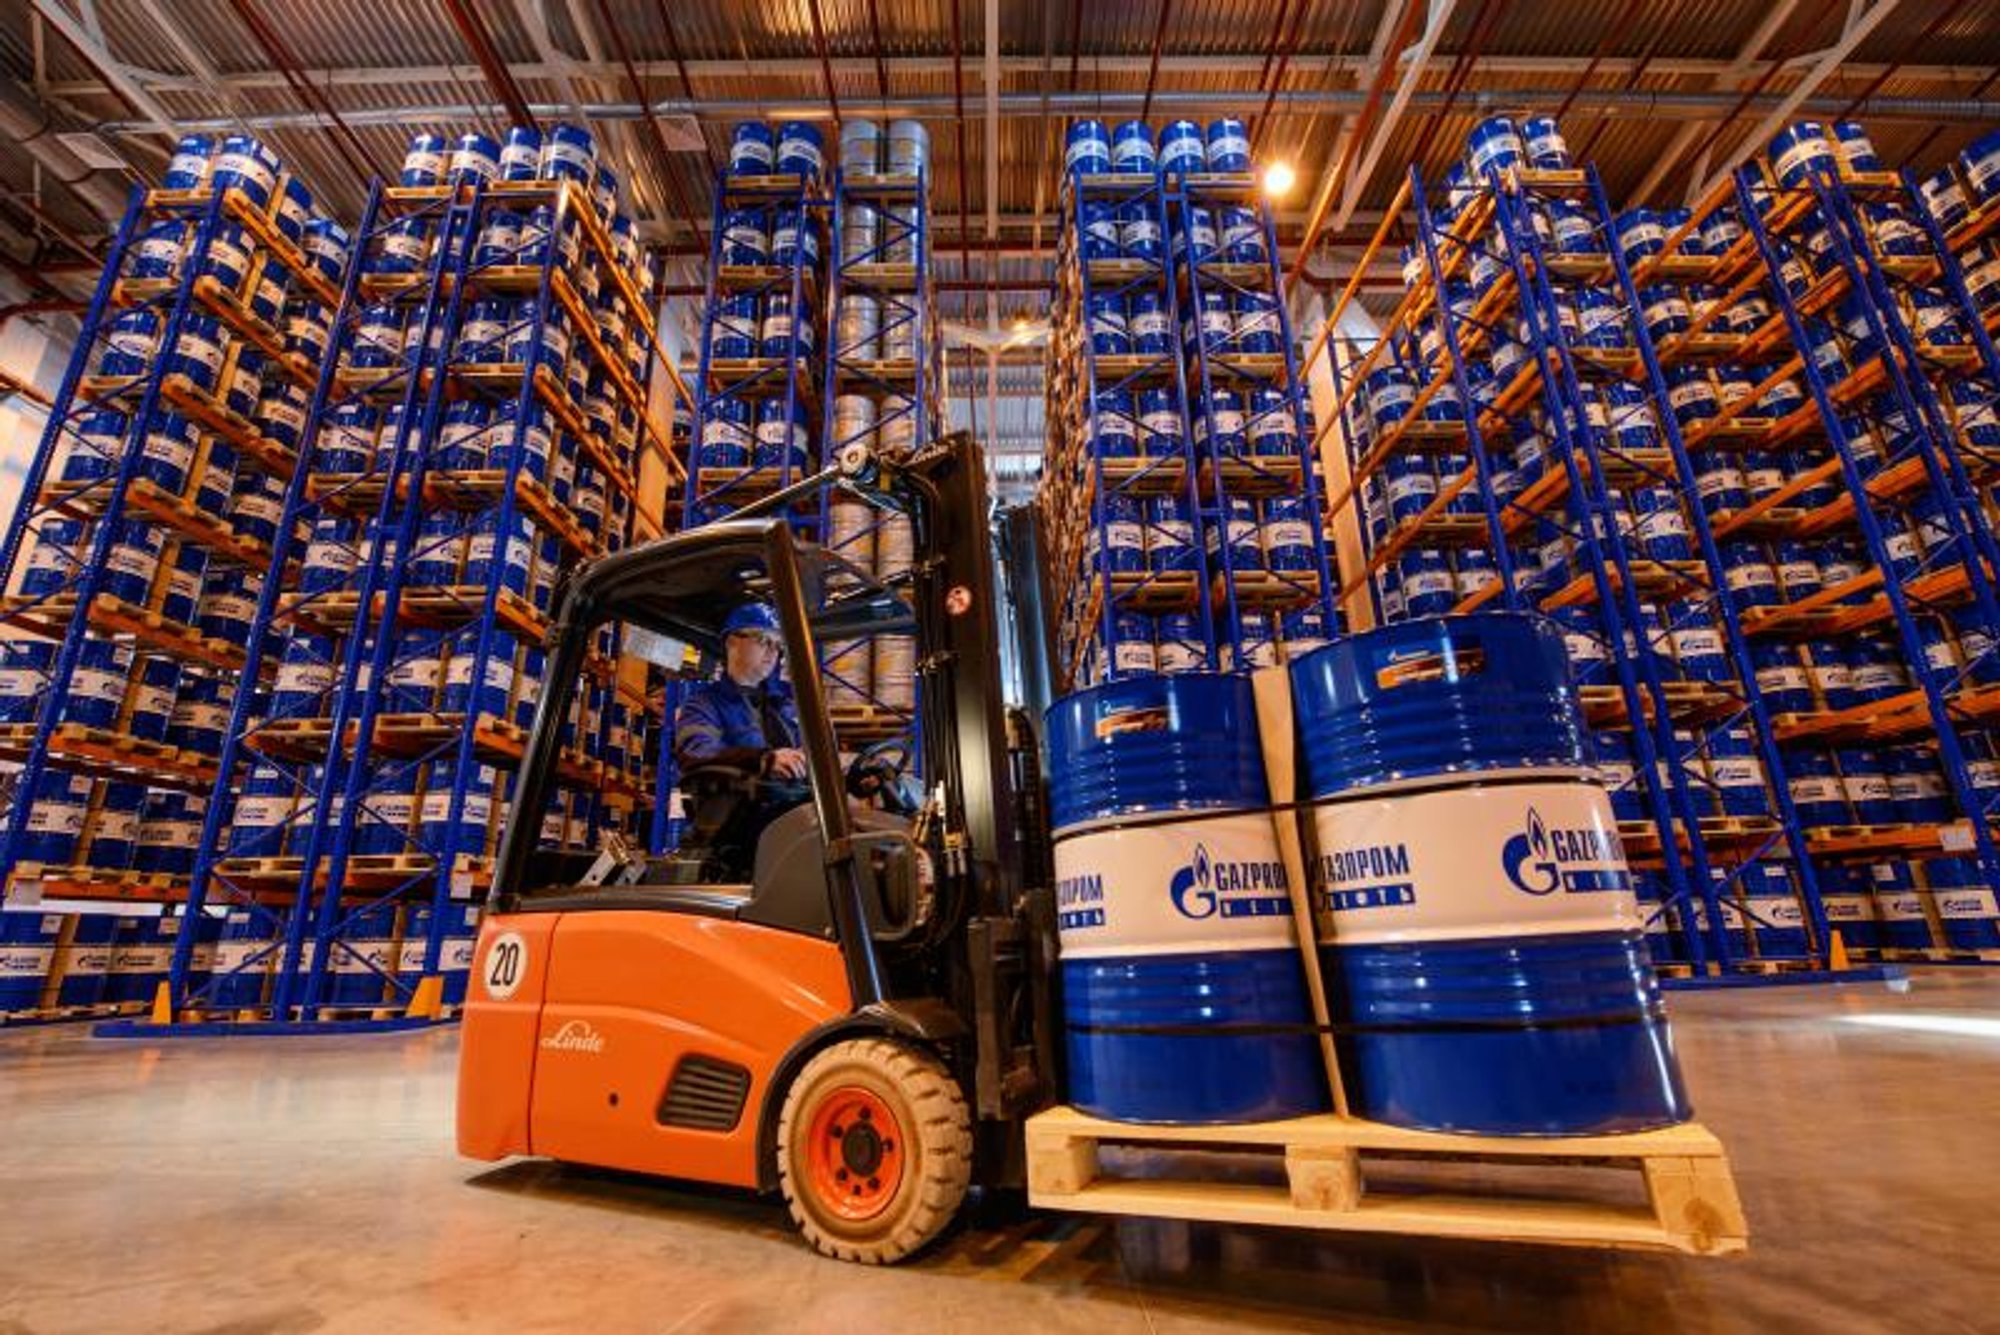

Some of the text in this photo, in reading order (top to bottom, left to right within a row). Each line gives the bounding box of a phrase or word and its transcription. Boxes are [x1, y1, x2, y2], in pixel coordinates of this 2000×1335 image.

[1214, 862, 1286, 891] GAZPRO
[1320, 844, 1410, 882] АЗПРОМ
[490, 942, 520, 986] 20
[541, 1020, 605, 1053] Linde
